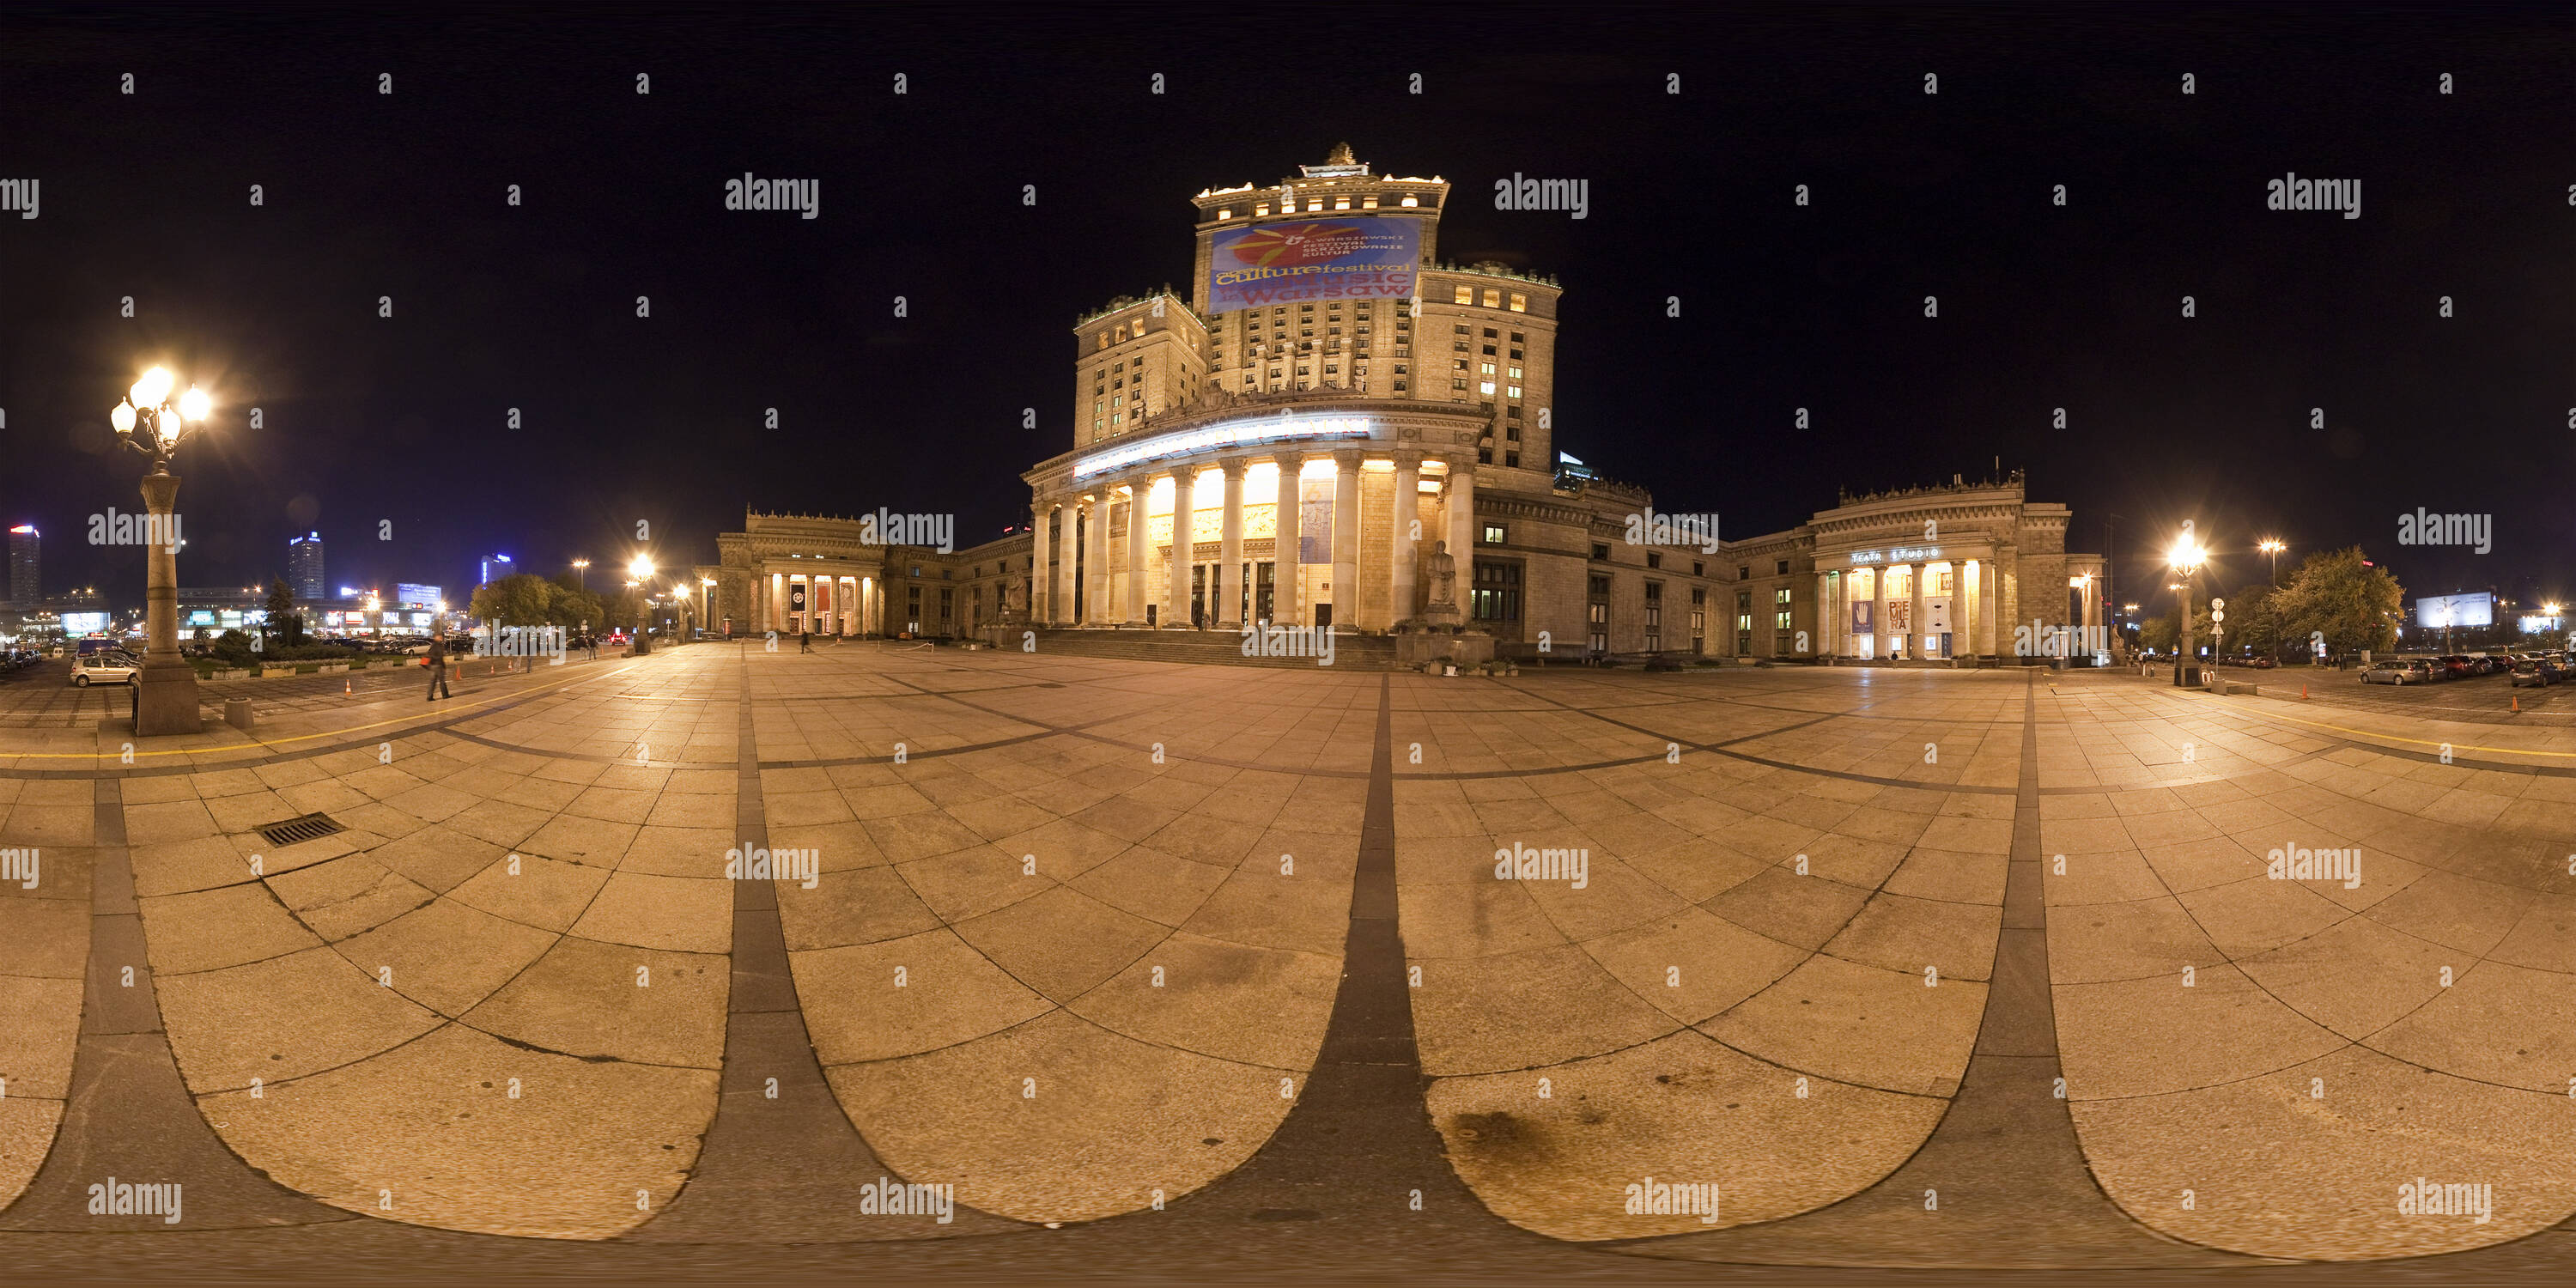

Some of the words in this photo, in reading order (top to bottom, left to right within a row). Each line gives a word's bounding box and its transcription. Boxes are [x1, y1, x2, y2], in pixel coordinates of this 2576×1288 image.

[1303, 240, 1364, 249] FESTIWAL
[1216, 264, 1321, 285] culture
[1321, 263, 1412, 274] festival
[1851, 553, 1881, 563] TEATR
[1892, 549, 1939, 560] STUDIO
